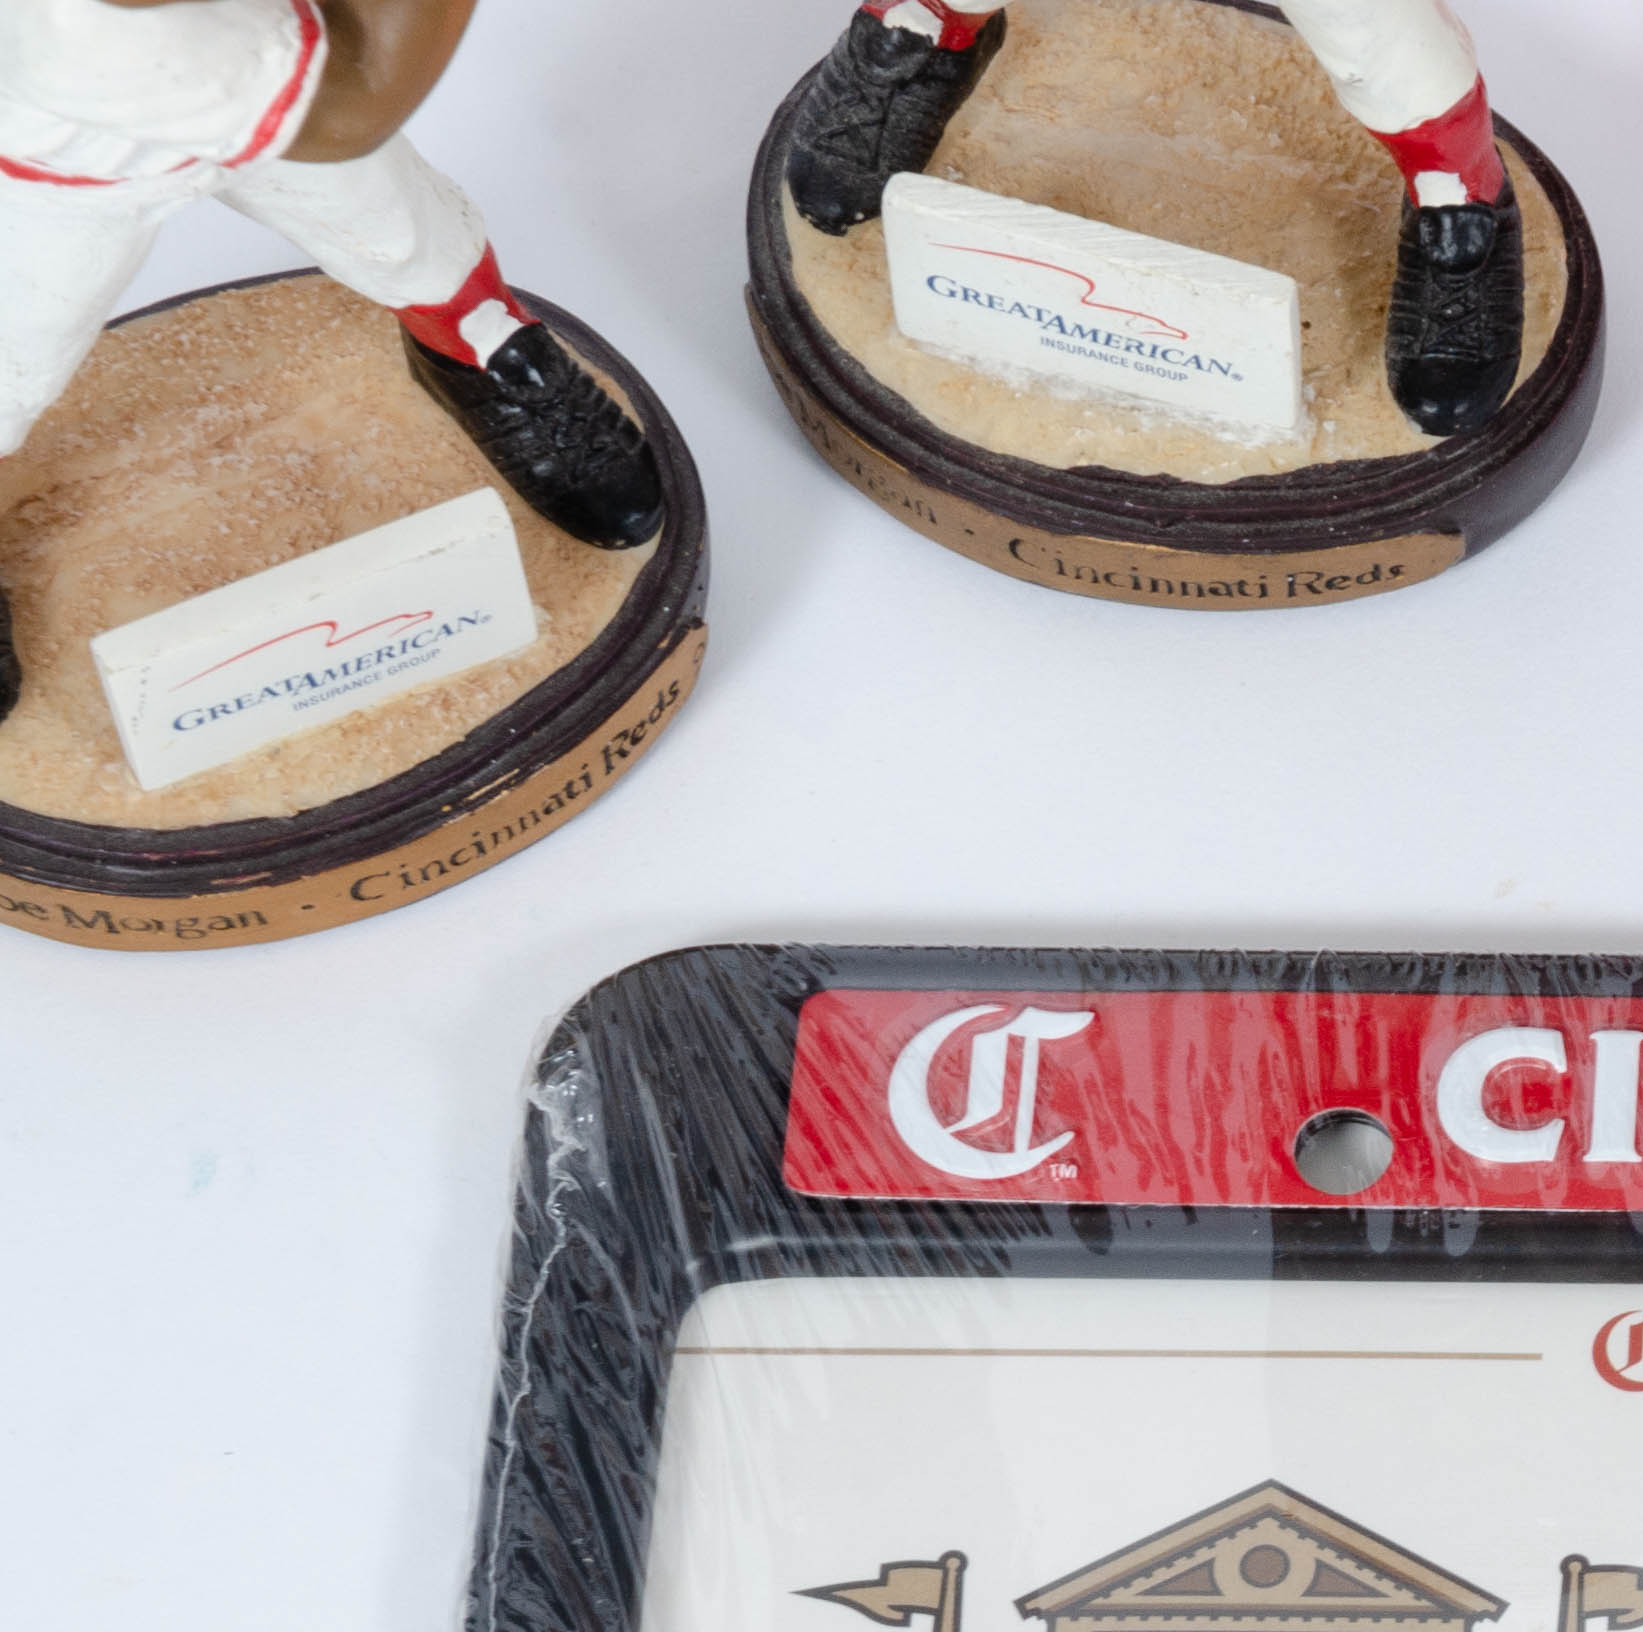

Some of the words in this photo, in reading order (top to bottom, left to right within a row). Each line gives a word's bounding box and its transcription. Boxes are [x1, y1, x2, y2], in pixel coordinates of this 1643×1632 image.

[1039, 335, 1130, 367] INSURANCE
[1133, 360, 1189, 383] GROUP
[1008, 538, 1268, 599] Cincinnati
[1286, 563, 1407, 599] Reds
[292, 670, 384, 711] INSURANCE
[387, 648, 441, 676] GROUP
[0, 892, 49, 921] oe
[57, 902, 268, 940] Morgan
[350, 763, 594, 902] Cincinnati
[601, 678, 681, 776] Reds
[1049, 1163, 1079, 1180] TM
